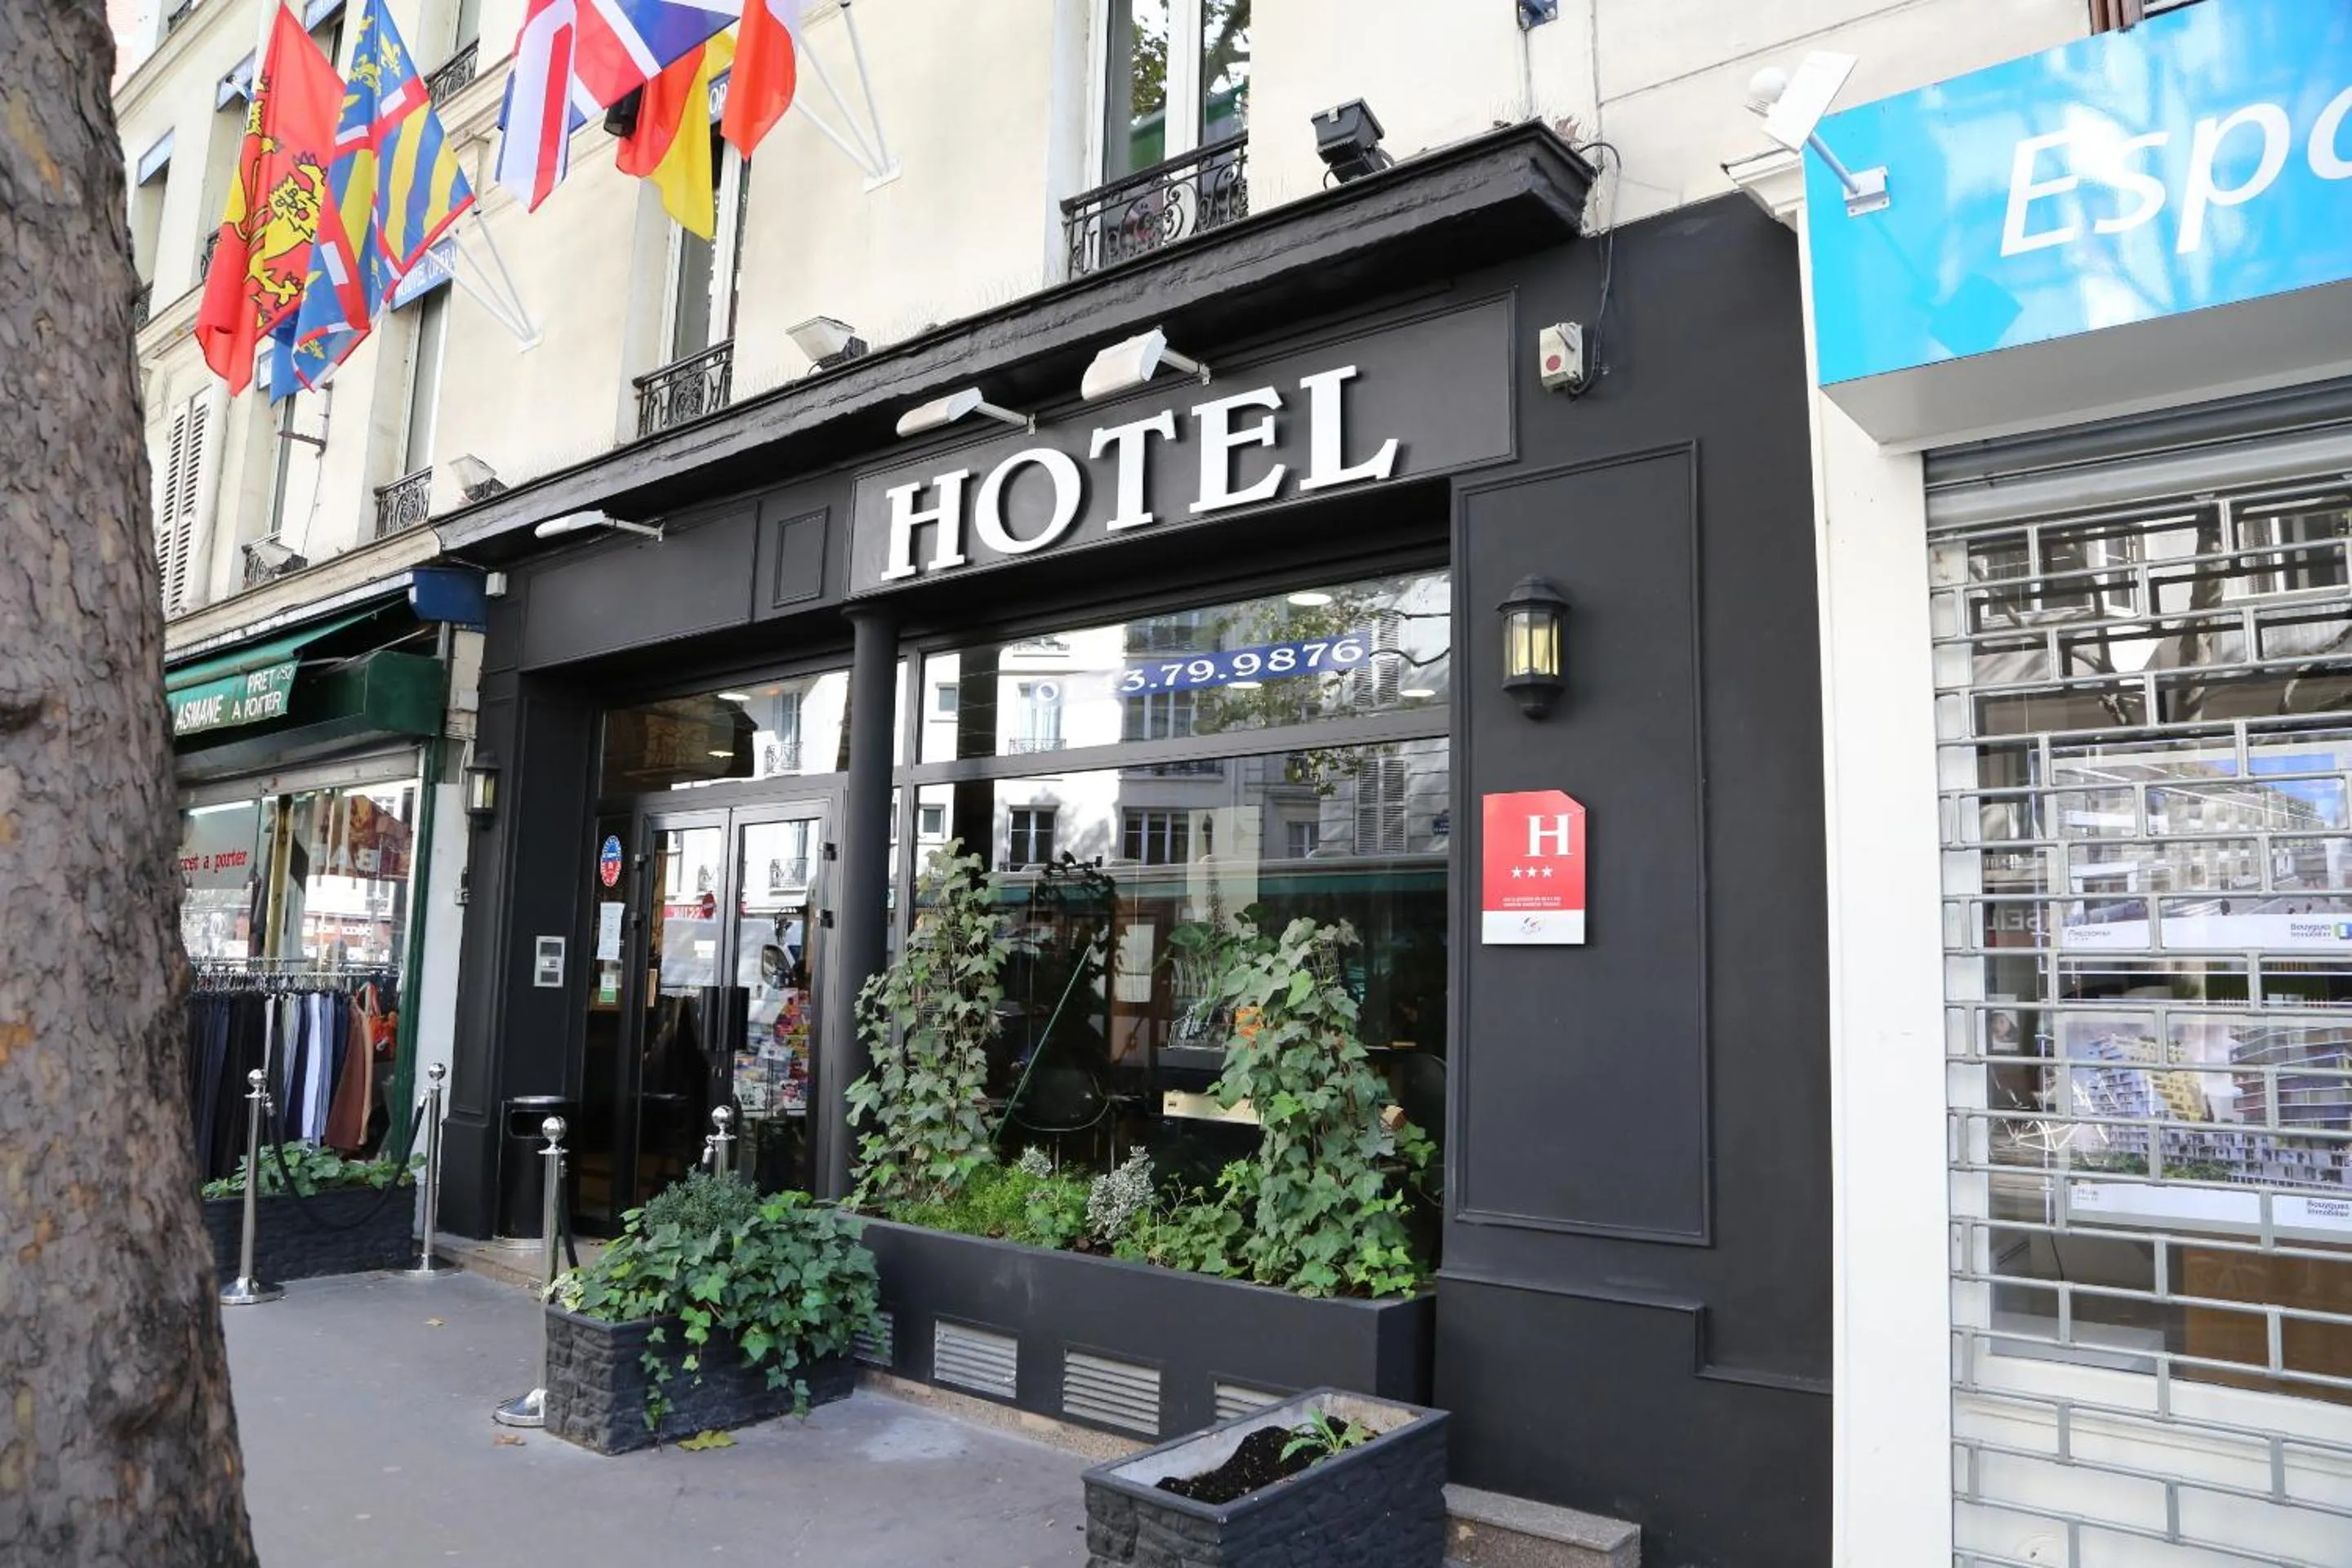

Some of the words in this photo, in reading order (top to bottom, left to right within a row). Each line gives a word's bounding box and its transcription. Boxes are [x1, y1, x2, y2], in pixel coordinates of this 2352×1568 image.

[880, 364, 1399, 581] HOTEL
[231, 701, 241, 722] A
[1522, 813, 1574, 858] H
